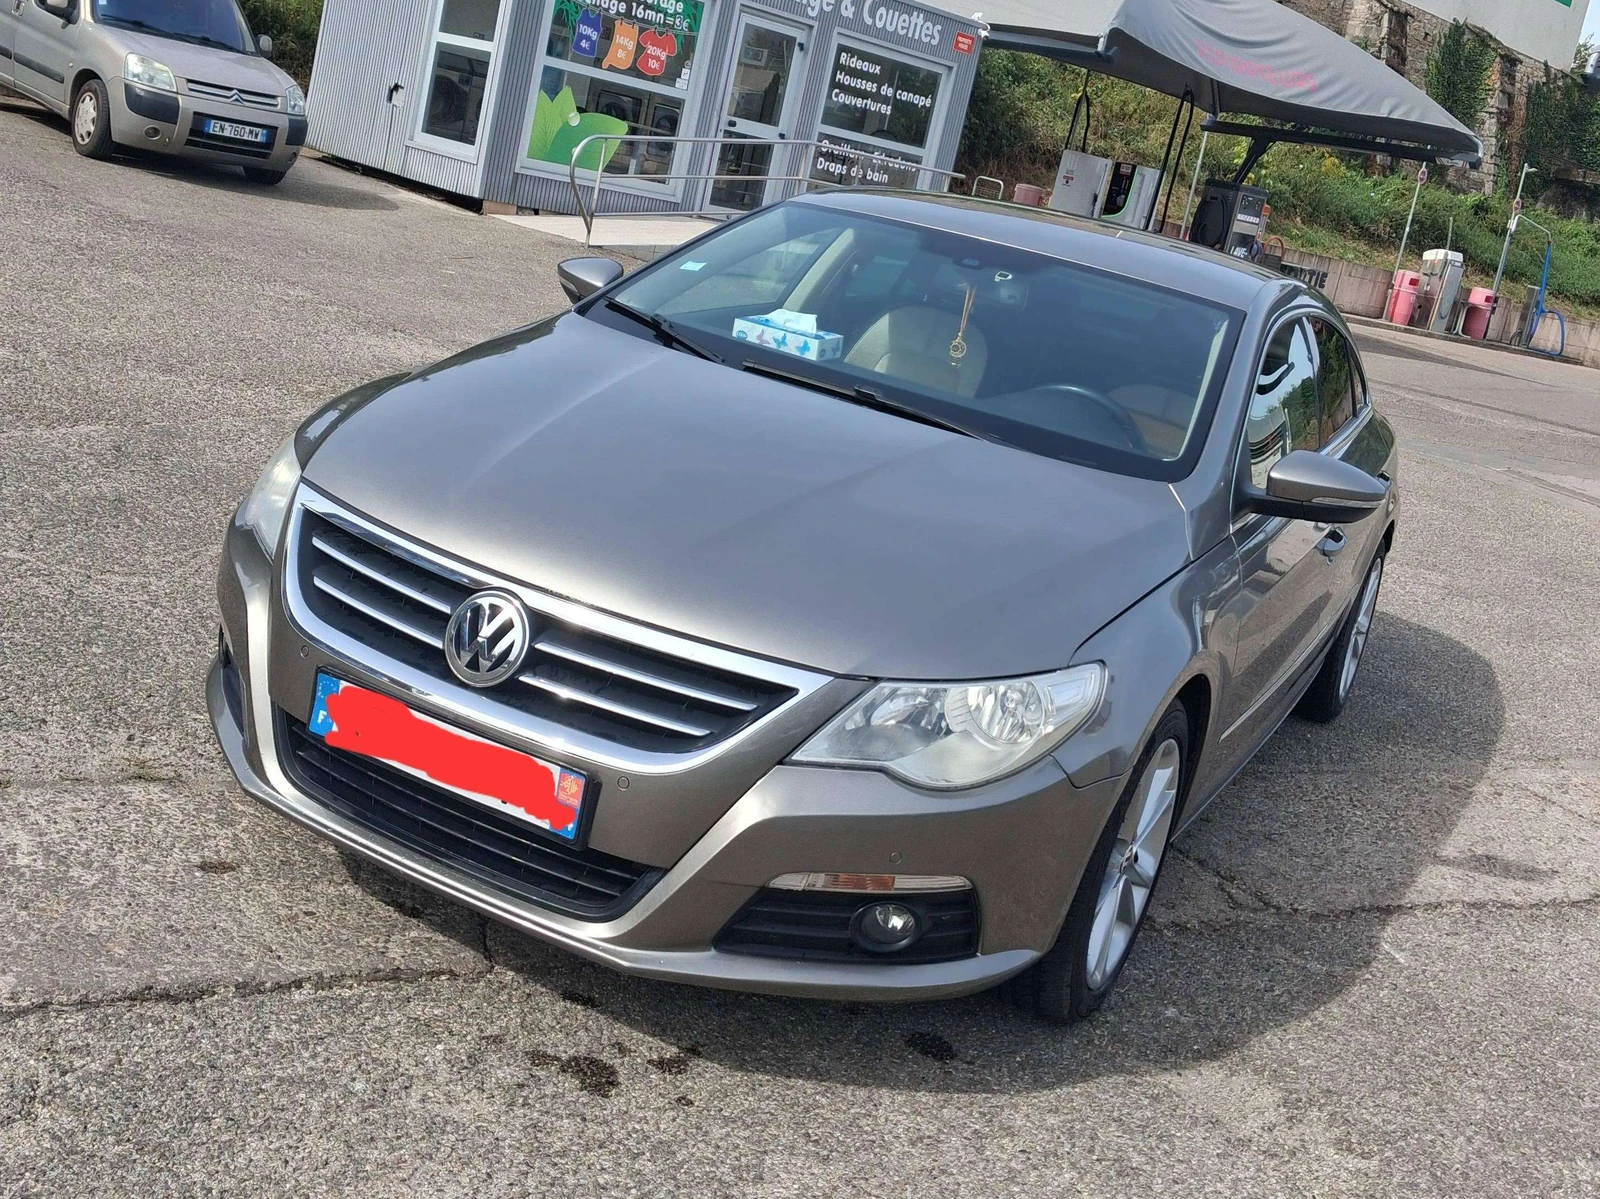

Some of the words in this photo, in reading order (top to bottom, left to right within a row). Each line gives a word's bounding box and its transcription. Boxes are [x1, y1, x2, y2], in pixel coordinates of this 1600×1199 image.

[863, 0, 942, 45] Couettes
[579, 24, 598, 40] 10Kg
[580, 39, 590, 50] 4€
[615, 34, 633, 50] 14Kg
[617, 49, 626, 60] 8€
[647, 45, 666, 60] 20Kg
[648, 59, 660, 70] 10€
[839, 52, 881, 75] Rideaux
[835, 70, 878, 93] Housses
[880, 83, 893, 97] de
[896, 89, 932, 108] canapé
[831, 88, 892, 115] Couvertures
[816, 157, 847, 176] Draps
[850, 164, 862, 178] de
[866, 167, 889, 183] bain
[317, 709, 328, 725] F
